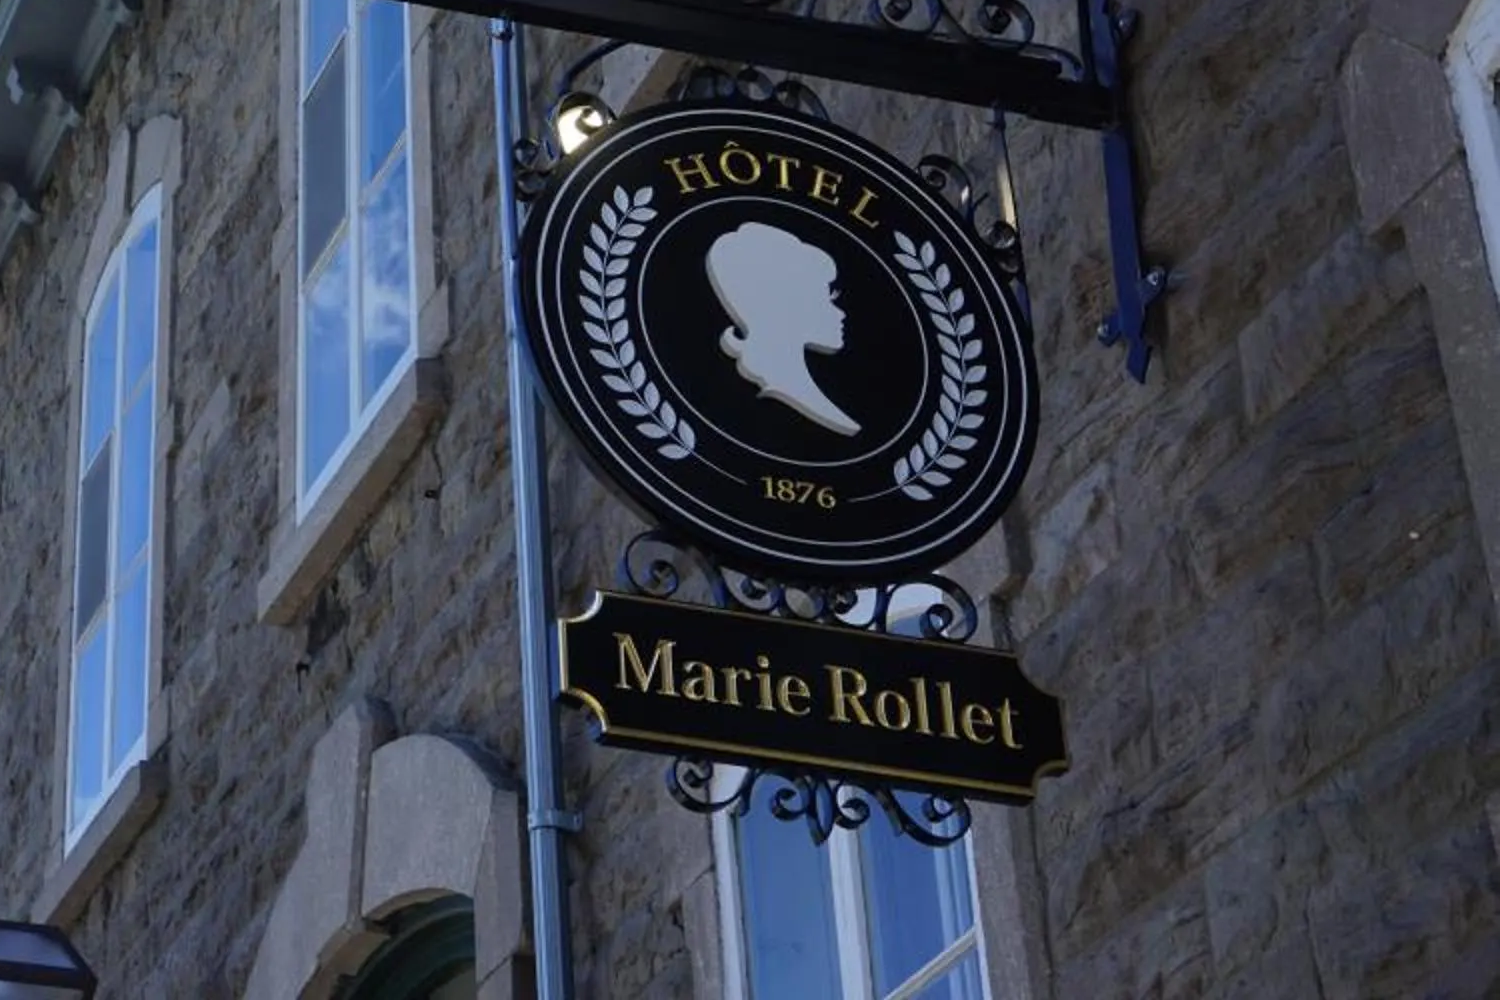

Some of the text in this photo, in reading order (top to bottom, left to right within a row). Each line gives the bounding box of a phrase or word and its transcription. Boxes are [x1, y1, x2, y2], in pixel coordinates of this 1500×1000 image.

[663, 140, 881, 229] HÔTEL
[760, 475, 837, 509] 1876
[612, 632, 1024, 751] Marie Rollet
